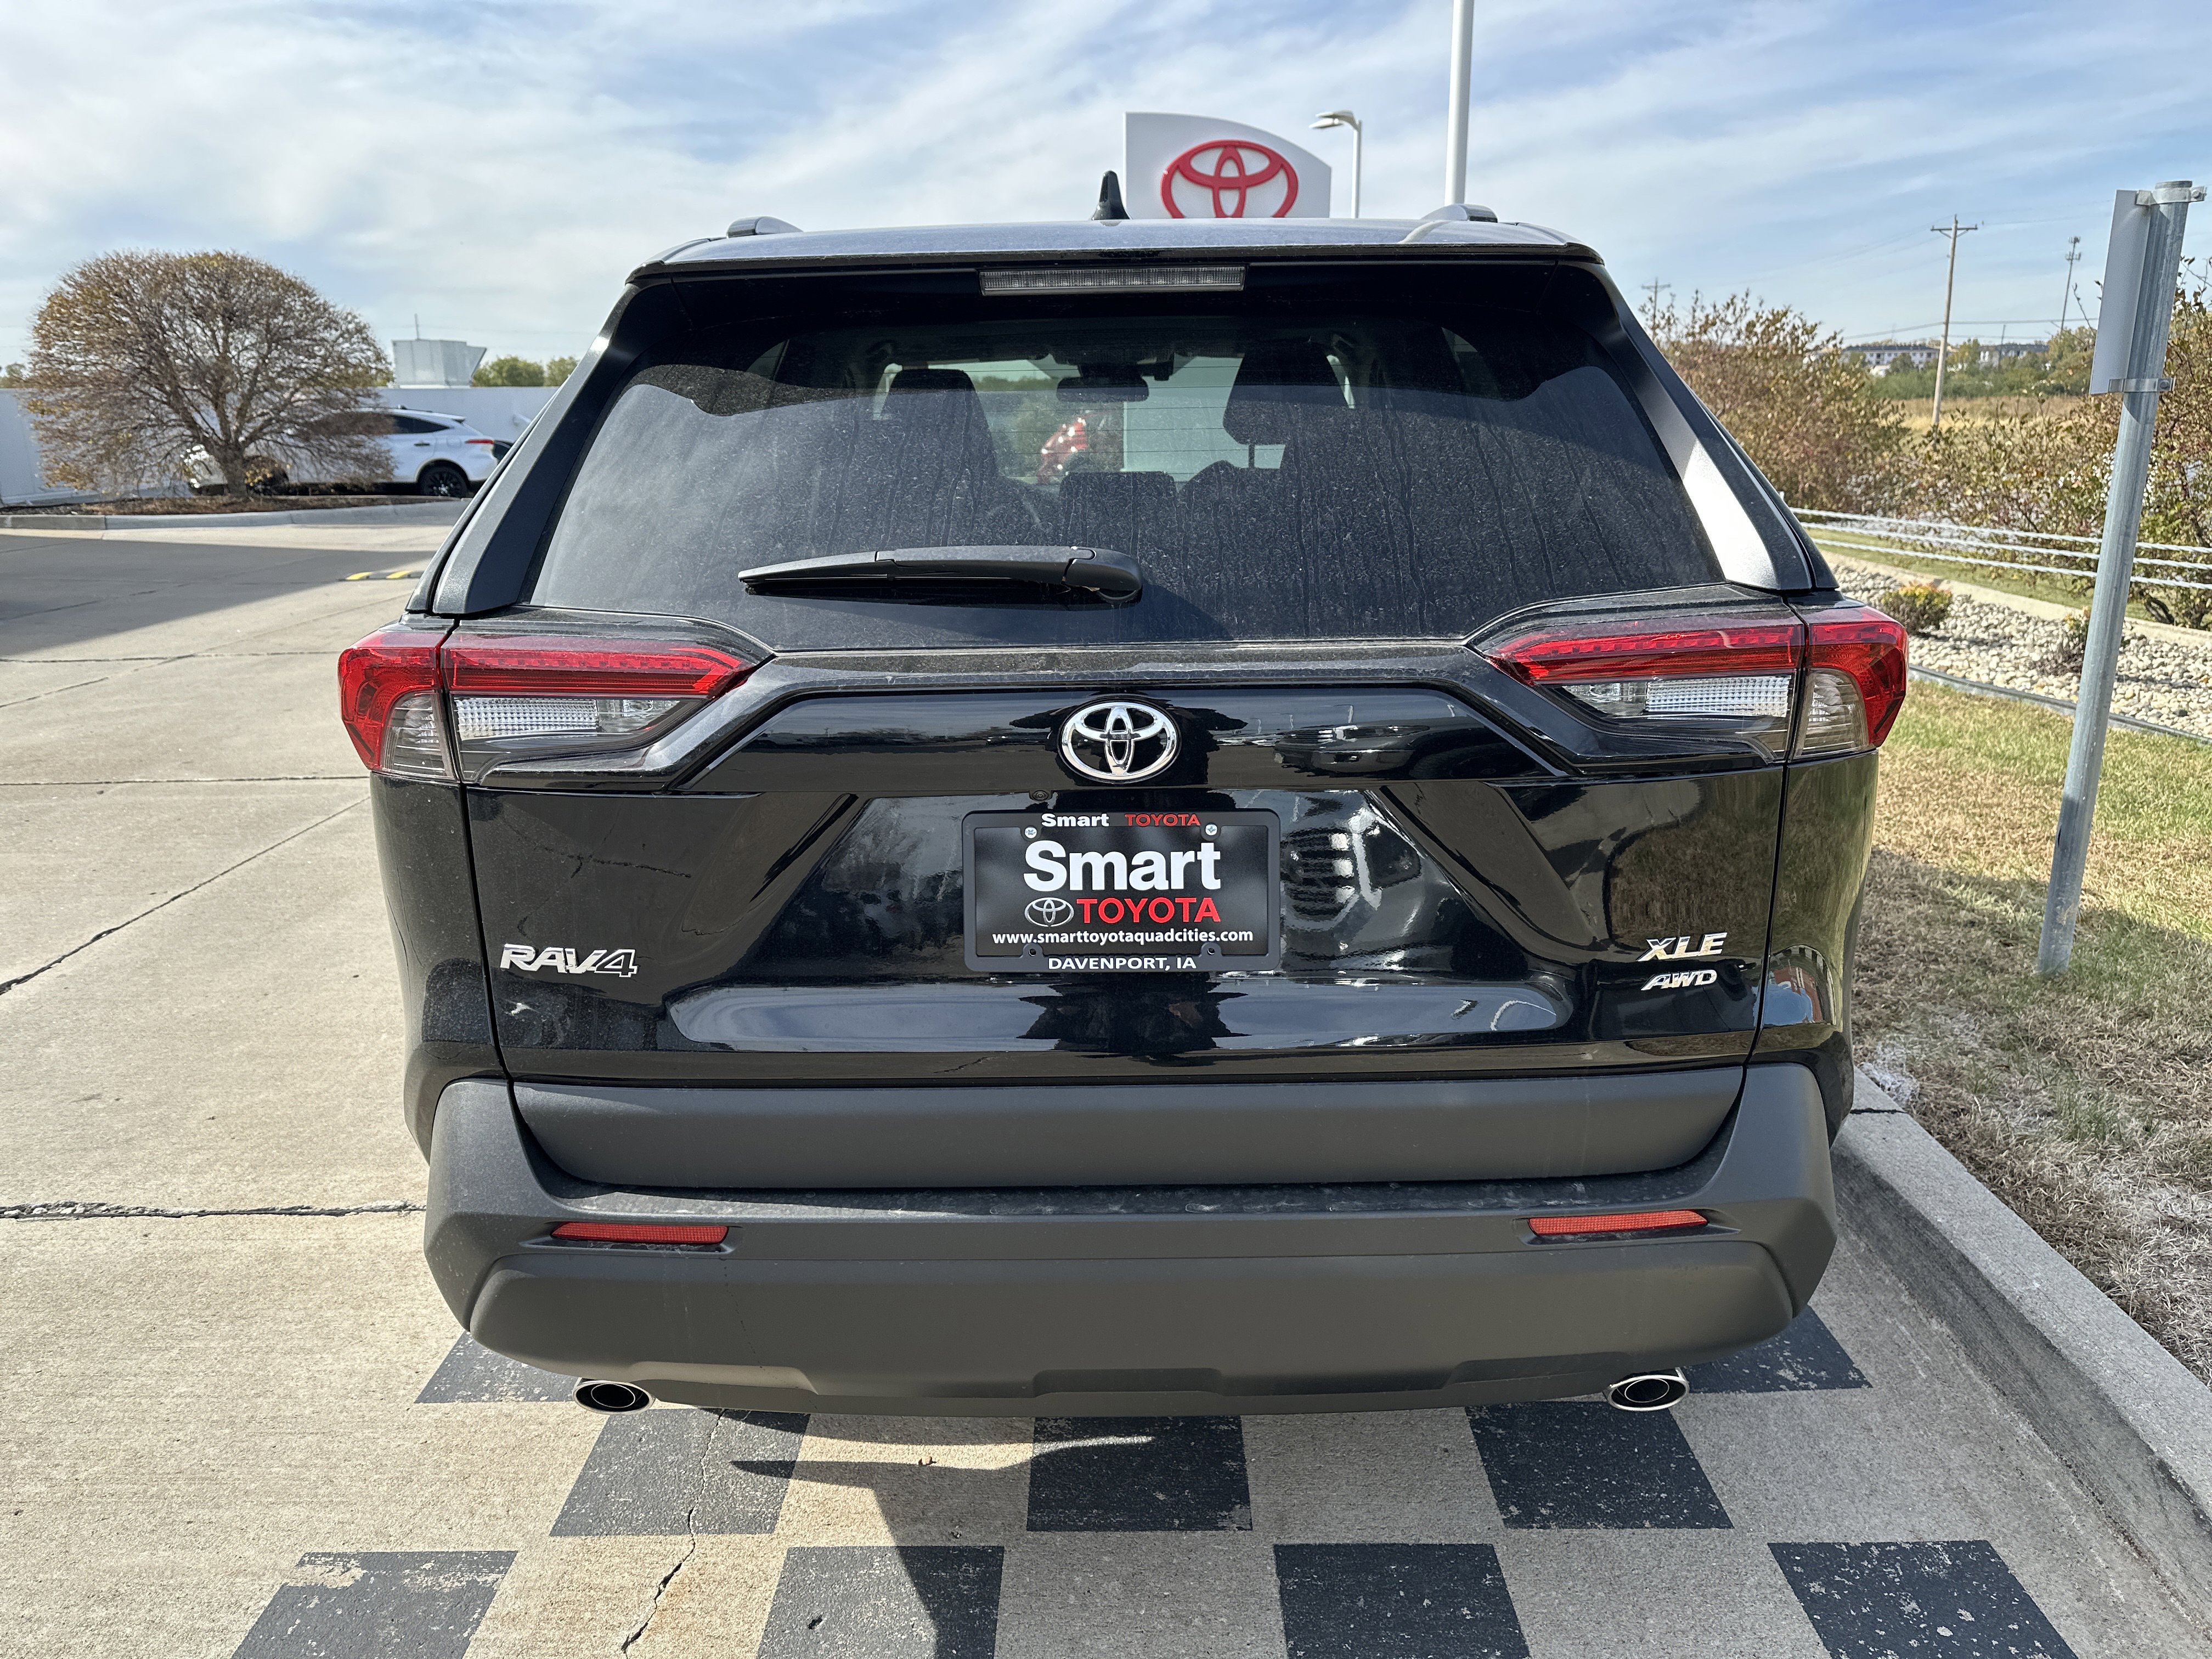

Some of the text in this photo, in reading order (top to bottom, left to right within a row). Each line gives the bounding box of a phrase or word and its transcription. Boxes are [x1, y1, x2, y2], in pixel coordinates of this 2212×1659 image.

[1041, 812, 1201, 827] Smart TOYOTA
[1023, 840, 1221, 891] Smart
[1076, 897, 1221, 923] TOYOTA
[992, 928, 1253, 946] www.smarttoyotaquadcities.com
[1637, 932, 1728, 961] XLE
[500, 943, 639, 977] RAV4
[1048, 957, 1197, 970] DAVENPORT, IA
[1640, 969, 1717, 991] AWD
